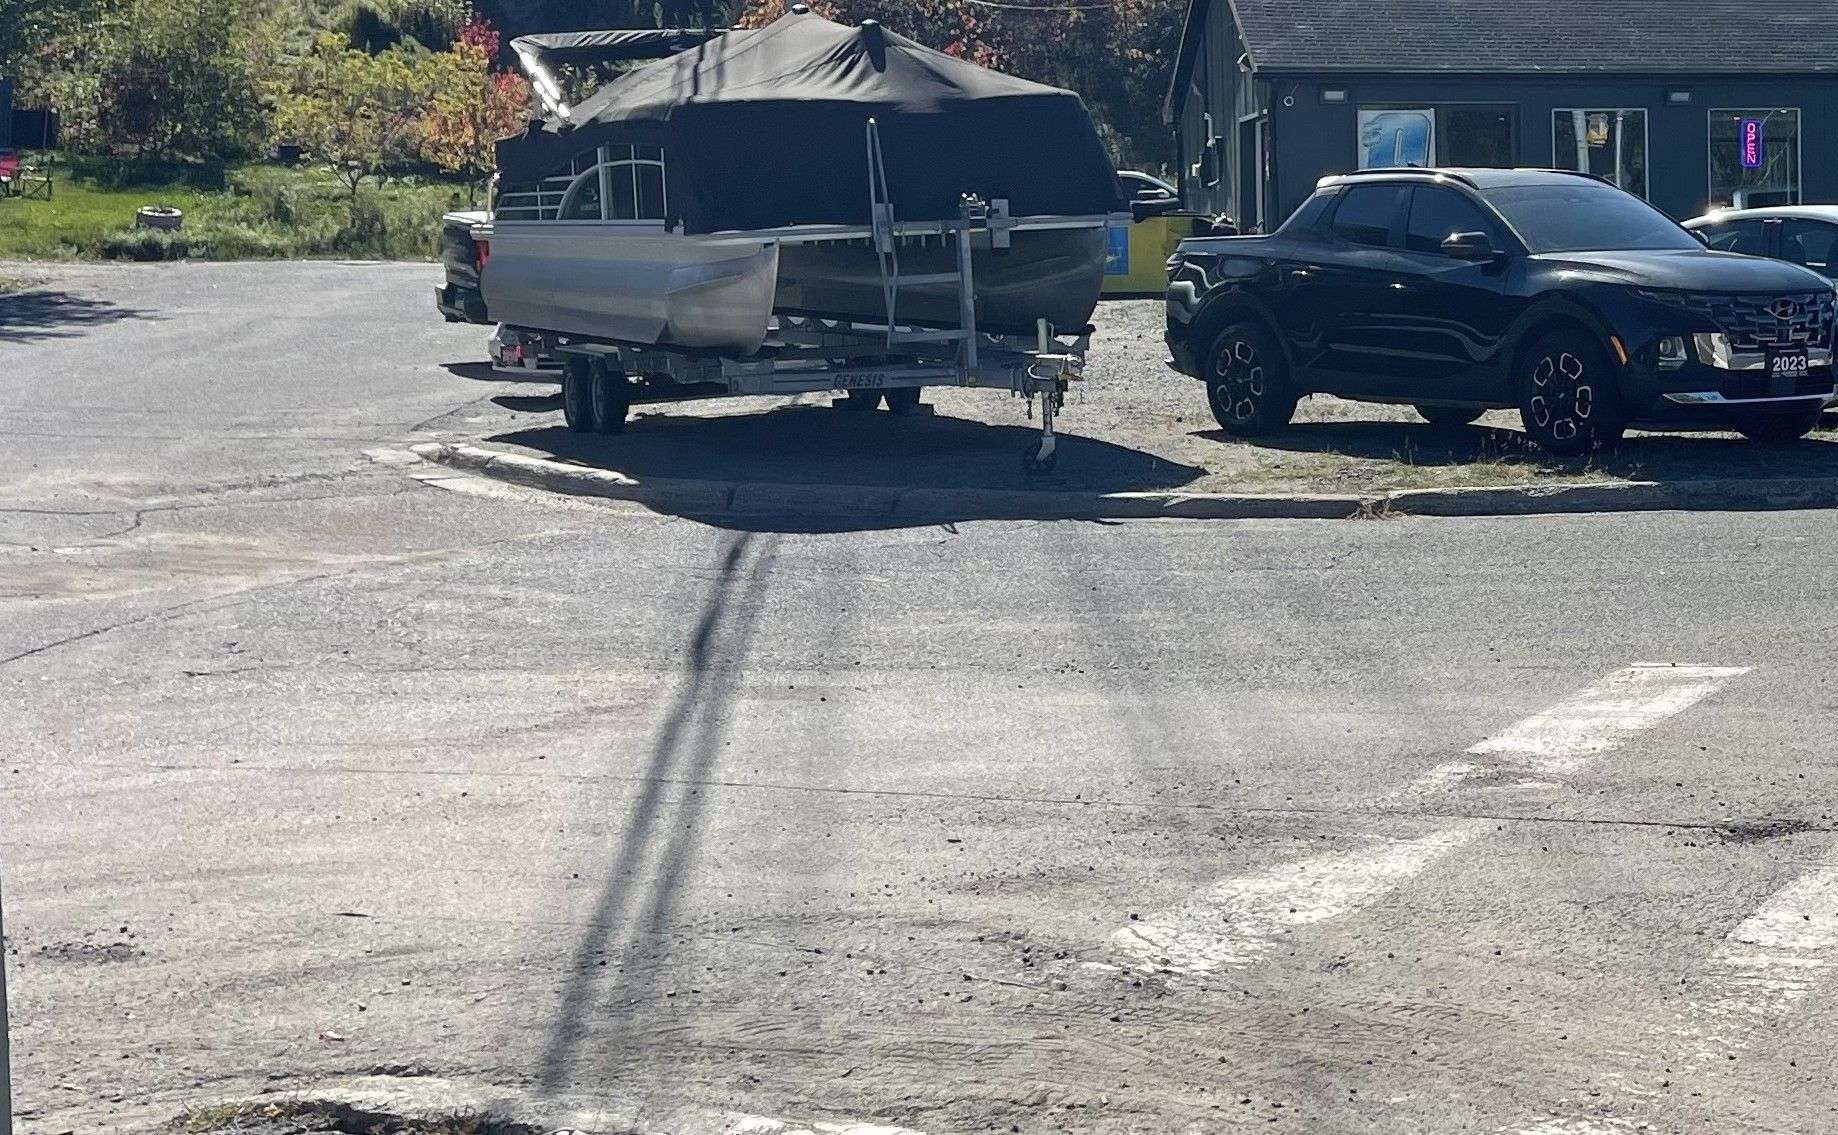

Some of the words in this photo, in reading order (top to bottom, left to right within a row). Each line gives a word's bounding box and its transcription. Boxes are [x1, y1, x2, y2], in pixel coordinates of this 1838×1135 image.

[1747, 122, 1756, 164] OPEN
[1773, 355, 1807, 372] 2023
[833, 373, 885, 387] GENESIS
